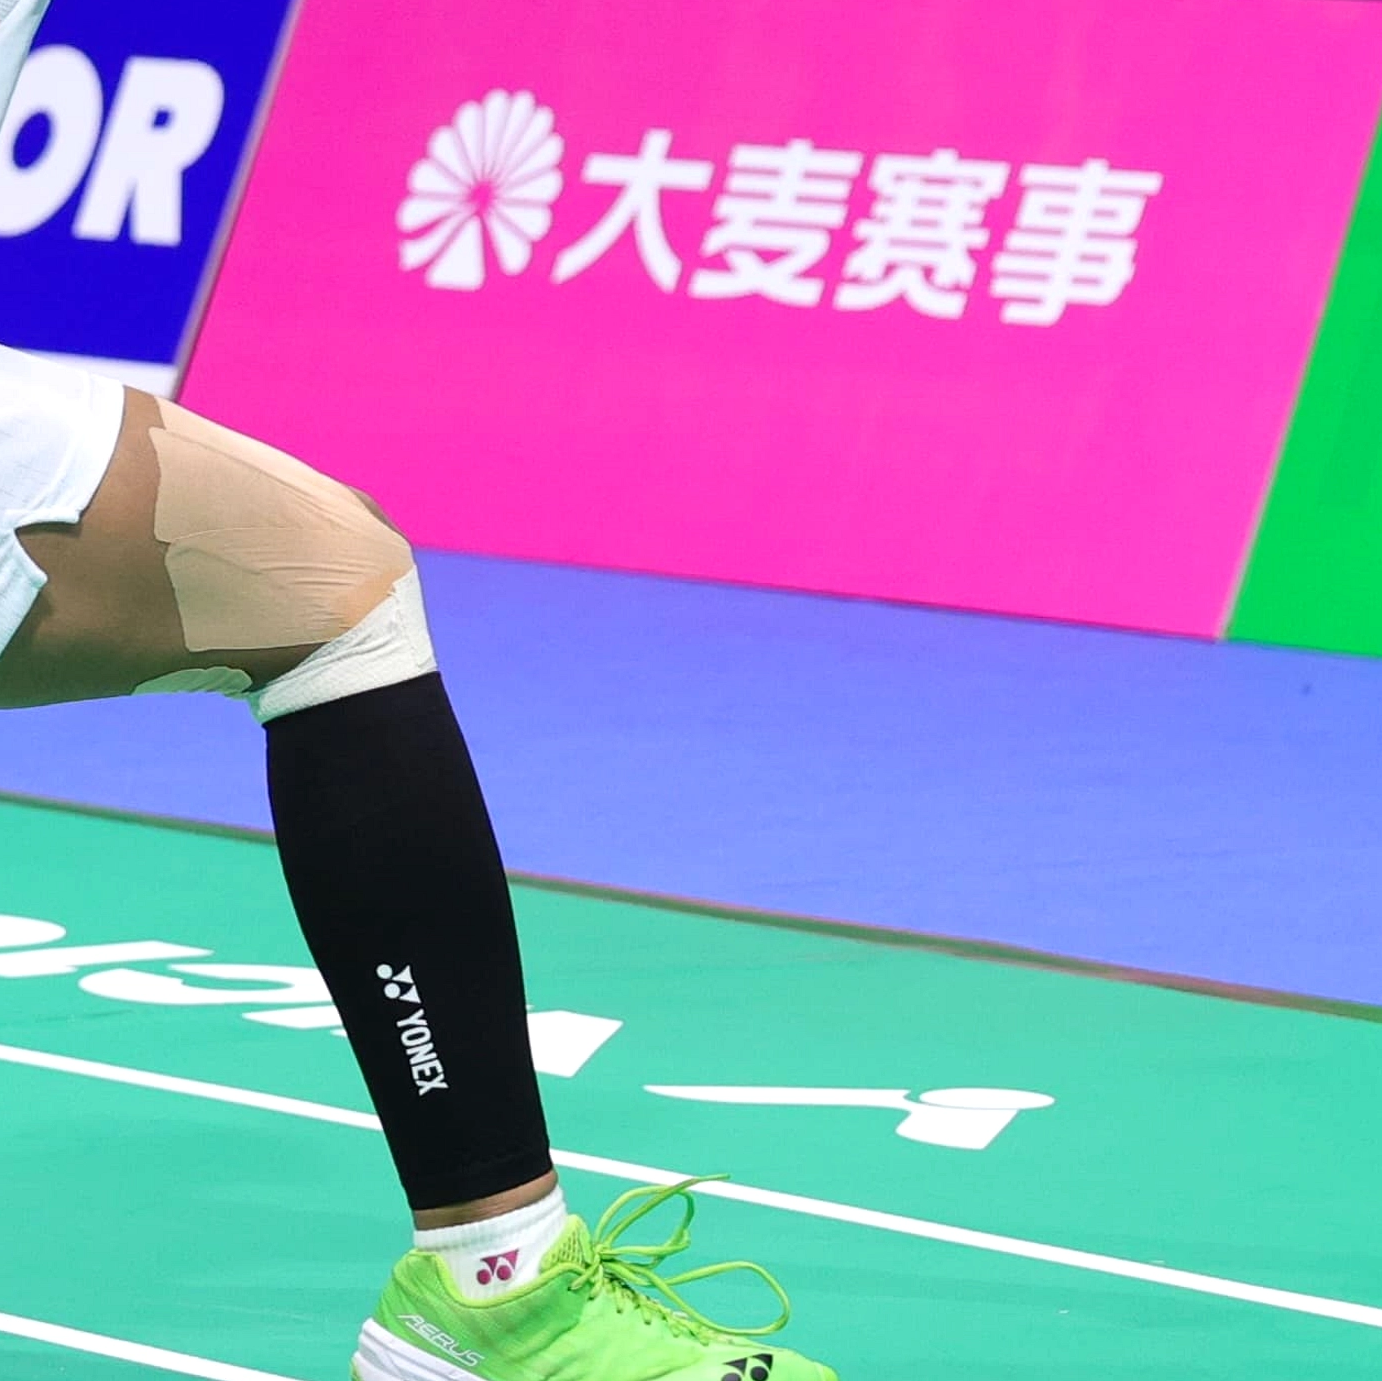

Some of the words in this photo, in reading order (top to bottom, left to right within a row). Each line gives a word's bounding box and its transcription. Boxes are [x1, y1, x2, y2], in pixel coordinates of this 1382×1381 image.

[550, 128, 1163, 326] 大麦赛事
[396, 1008, 449, 1096] YONEX
